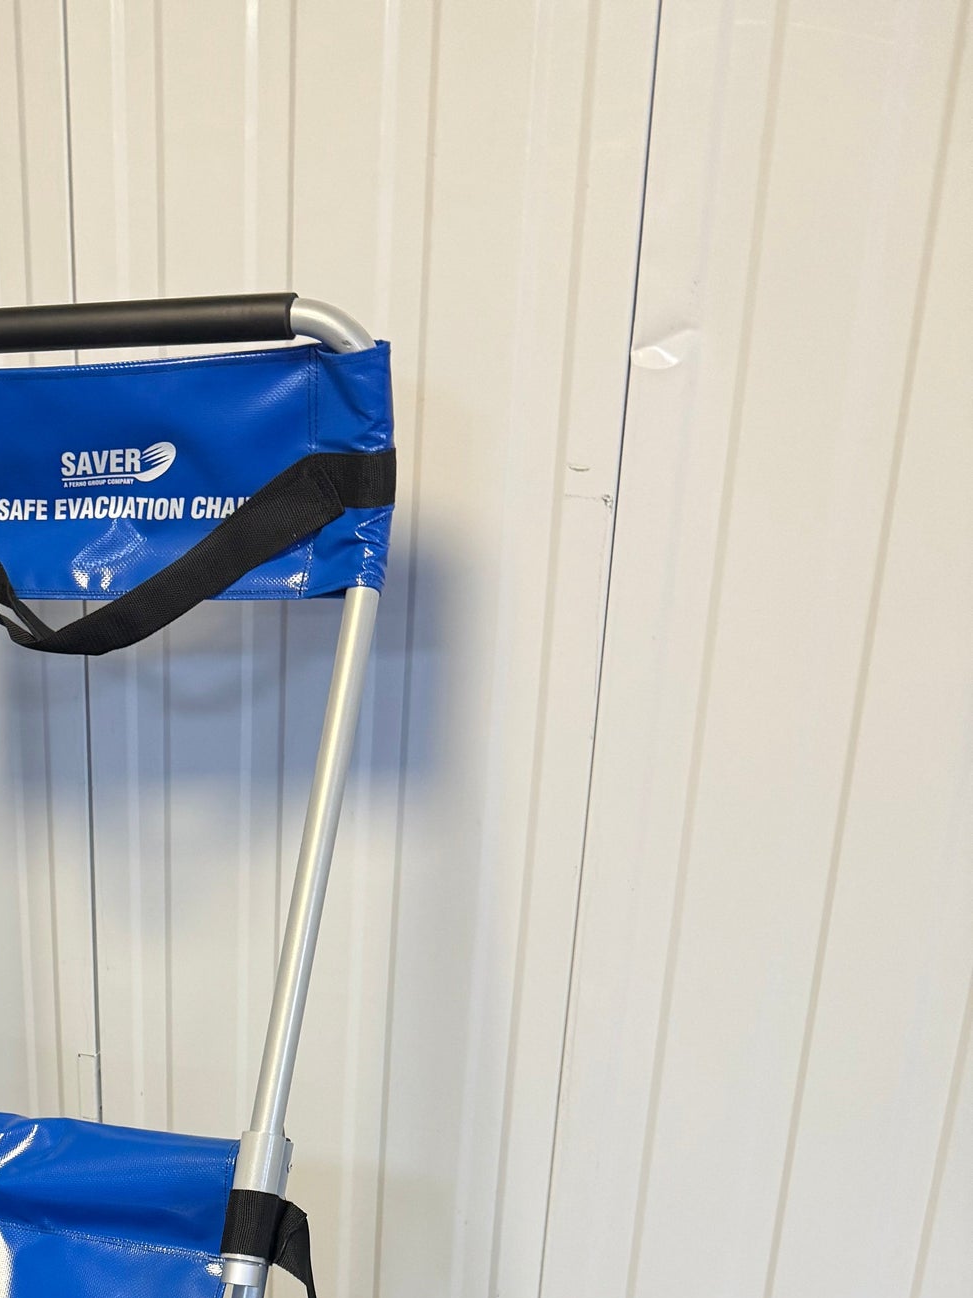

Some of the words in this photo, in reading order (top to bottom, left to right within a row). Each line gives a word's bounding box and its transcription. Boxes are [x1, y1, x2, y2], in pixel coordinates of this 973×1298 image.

[61, 448, 142, 477] SAVER
[87, 479, 107, 487] GROUP
[107, 478, 134, 486] COMPANY
[54, 496, 183, 521] EVACUATION
[190, 496, 252, 520] CHA
